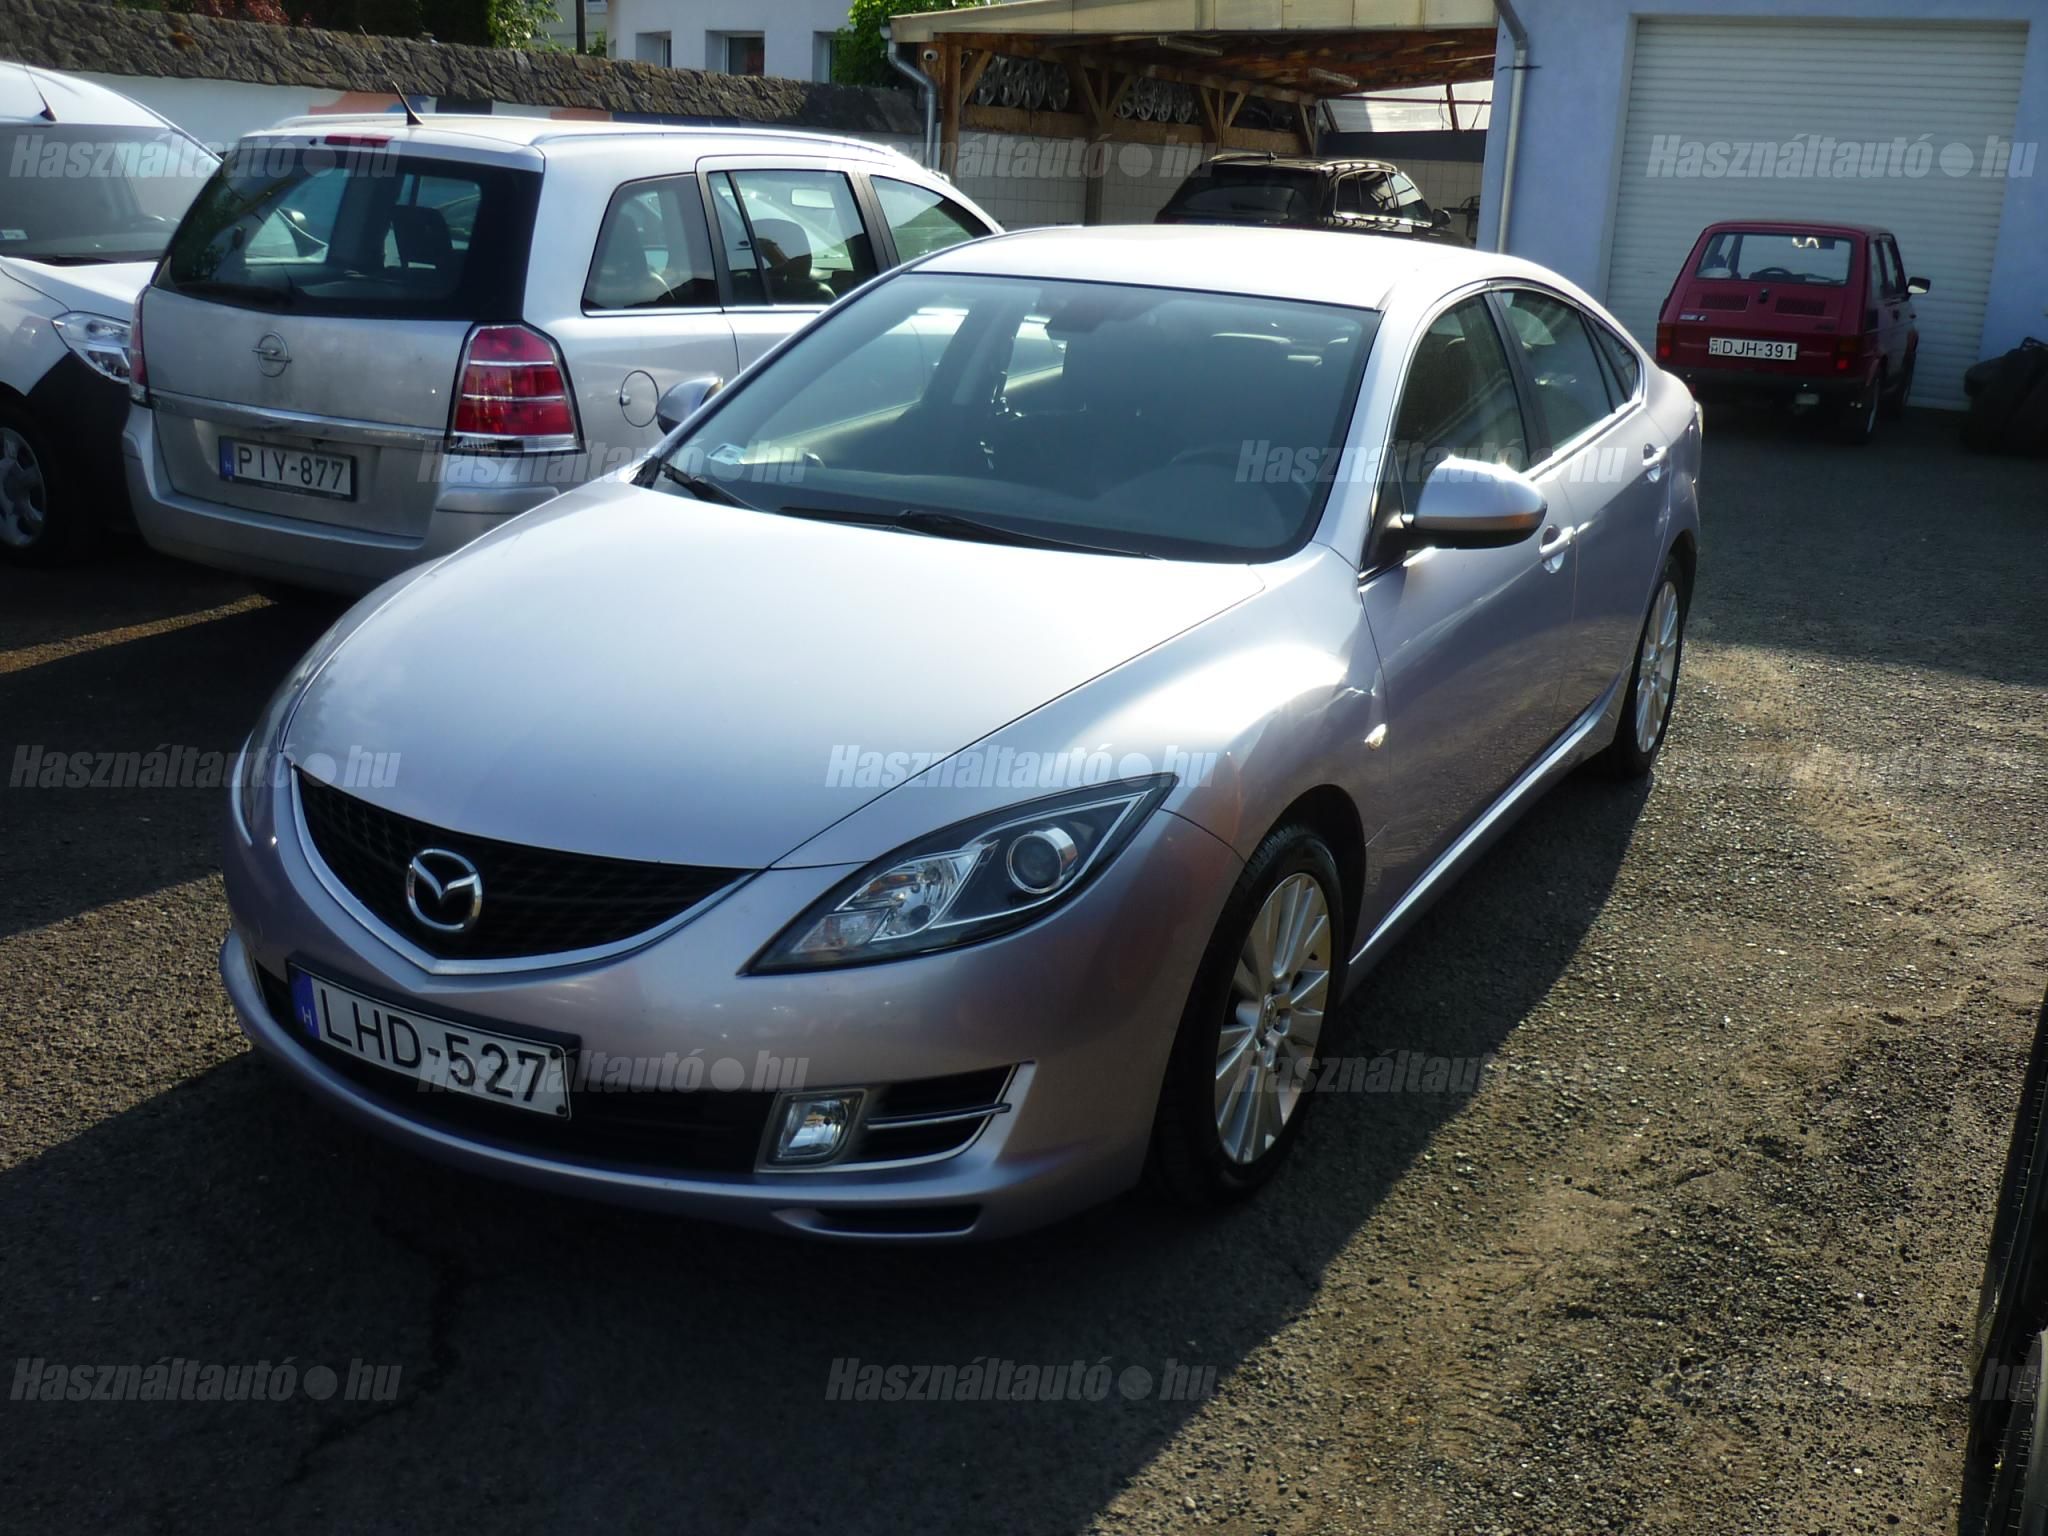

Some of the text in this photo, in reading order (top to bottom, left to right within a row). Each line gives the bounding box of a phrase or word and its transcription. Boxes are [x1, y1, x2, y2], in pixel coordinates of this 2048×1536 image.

[1722, 340, 1793, 359] DJH-391
[238, 446, 344, 490] PIY-877
[320, 988, 547, 1102] LHD-527
